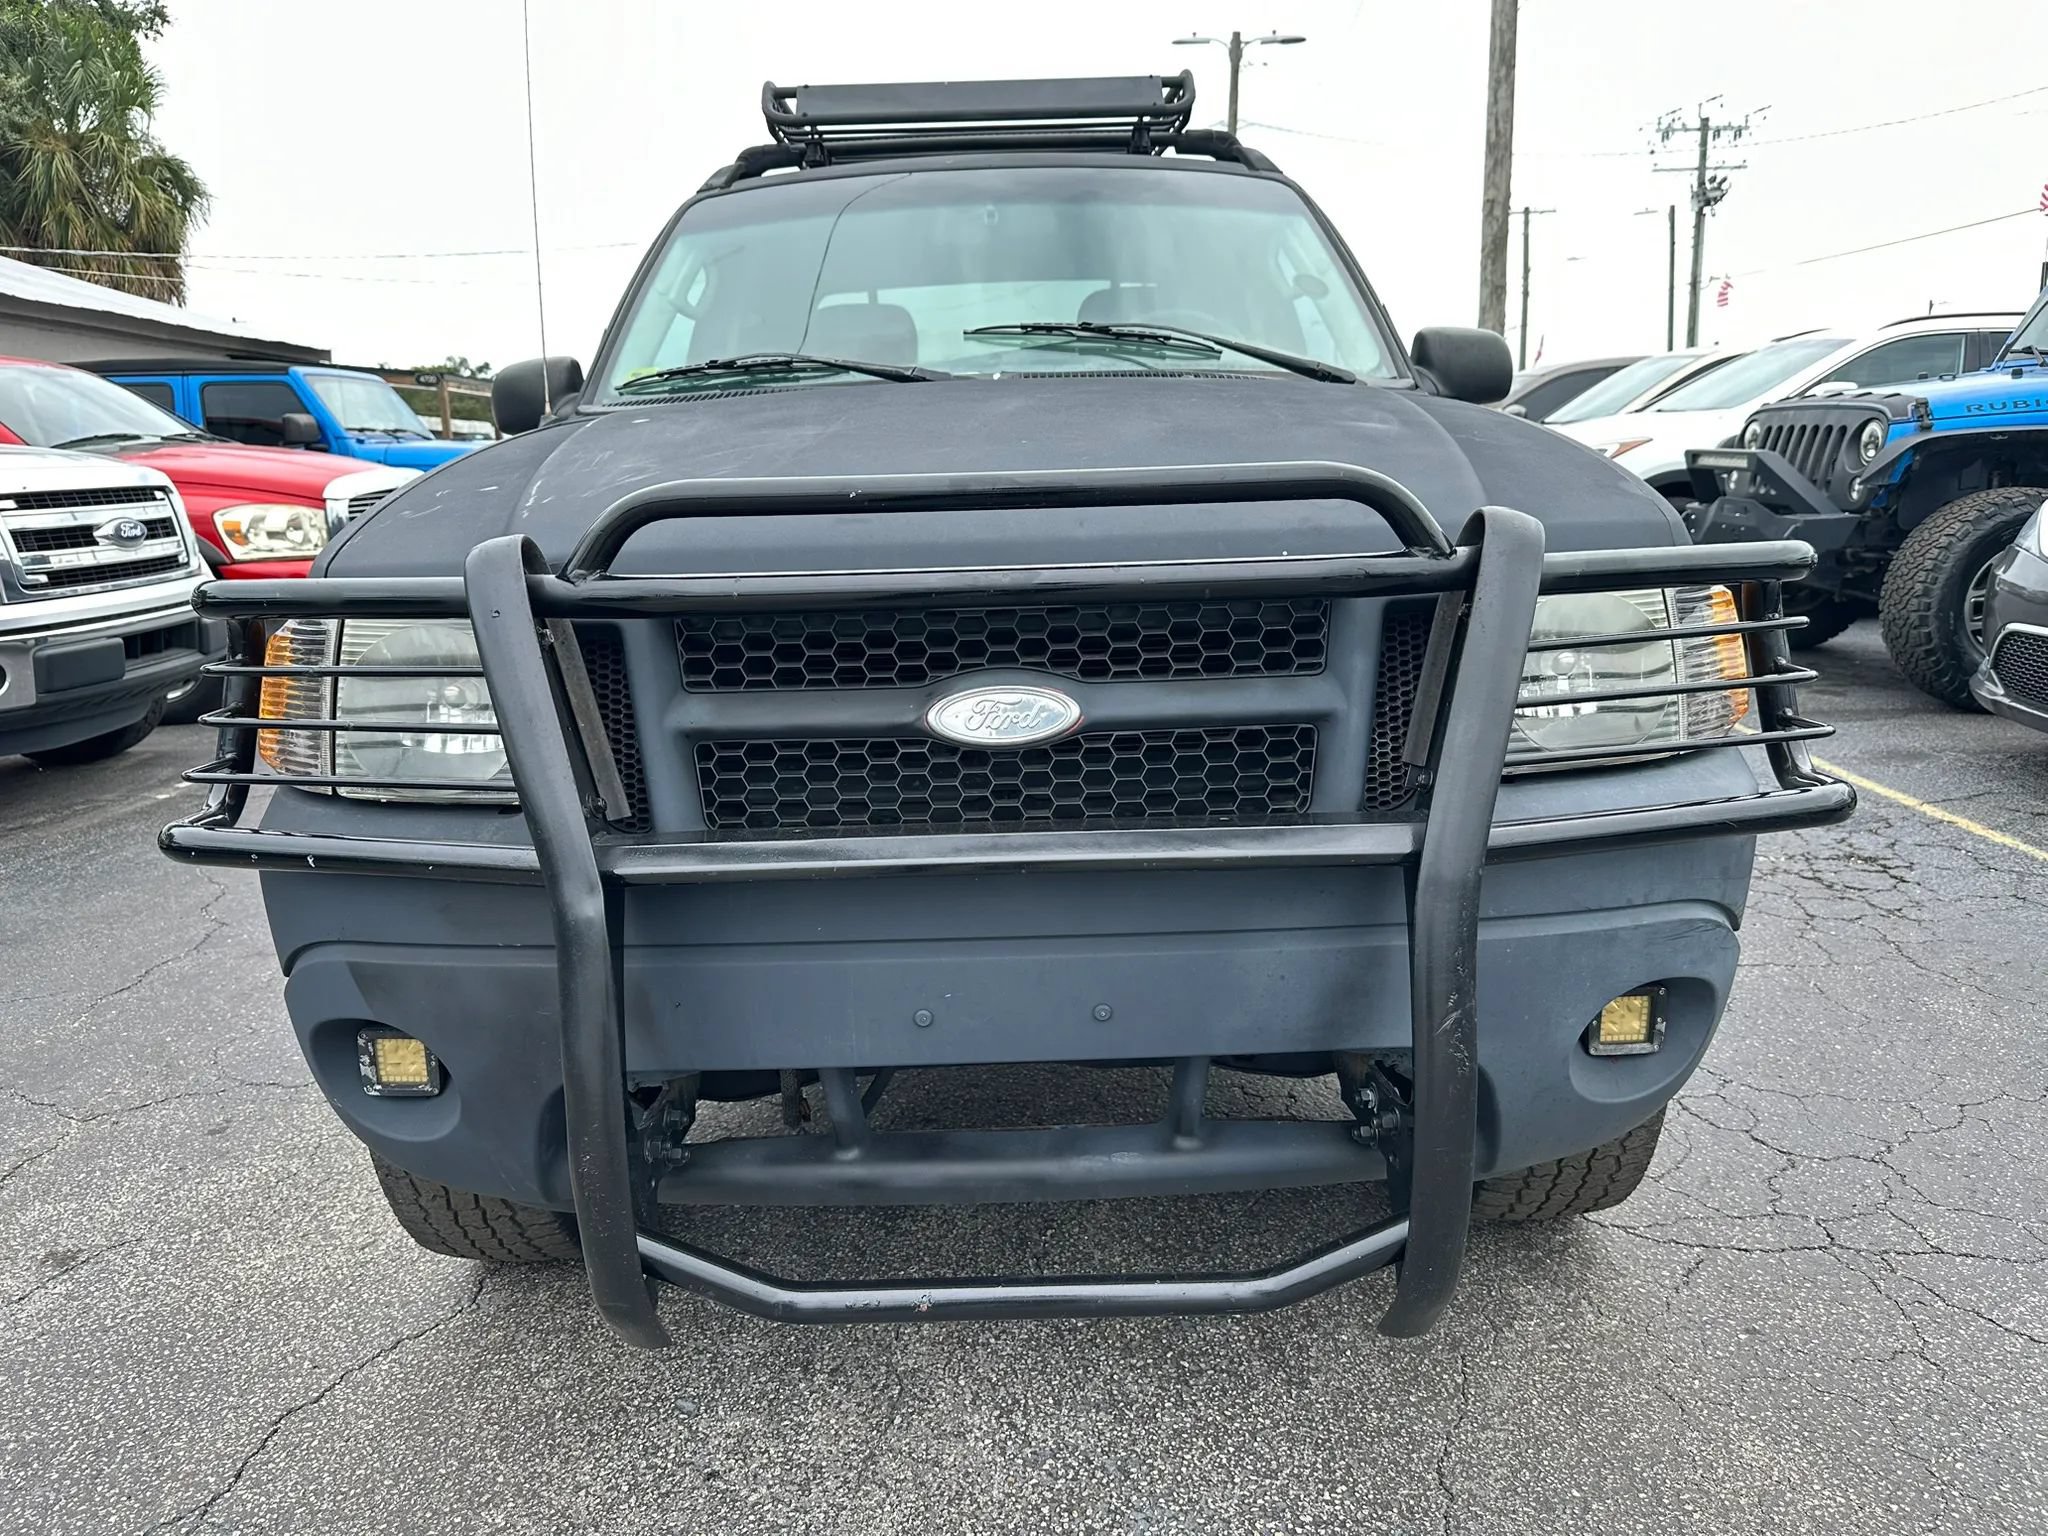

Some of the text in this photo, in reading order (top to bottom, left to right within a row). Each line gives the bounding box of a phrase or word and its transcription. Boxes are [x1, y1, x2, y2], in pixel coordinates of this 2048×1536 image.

[1966, 399, 2048, 412] RUBI
[120, 522, 142, 538] Ford
[964, 699, 1043, 731] Ford
